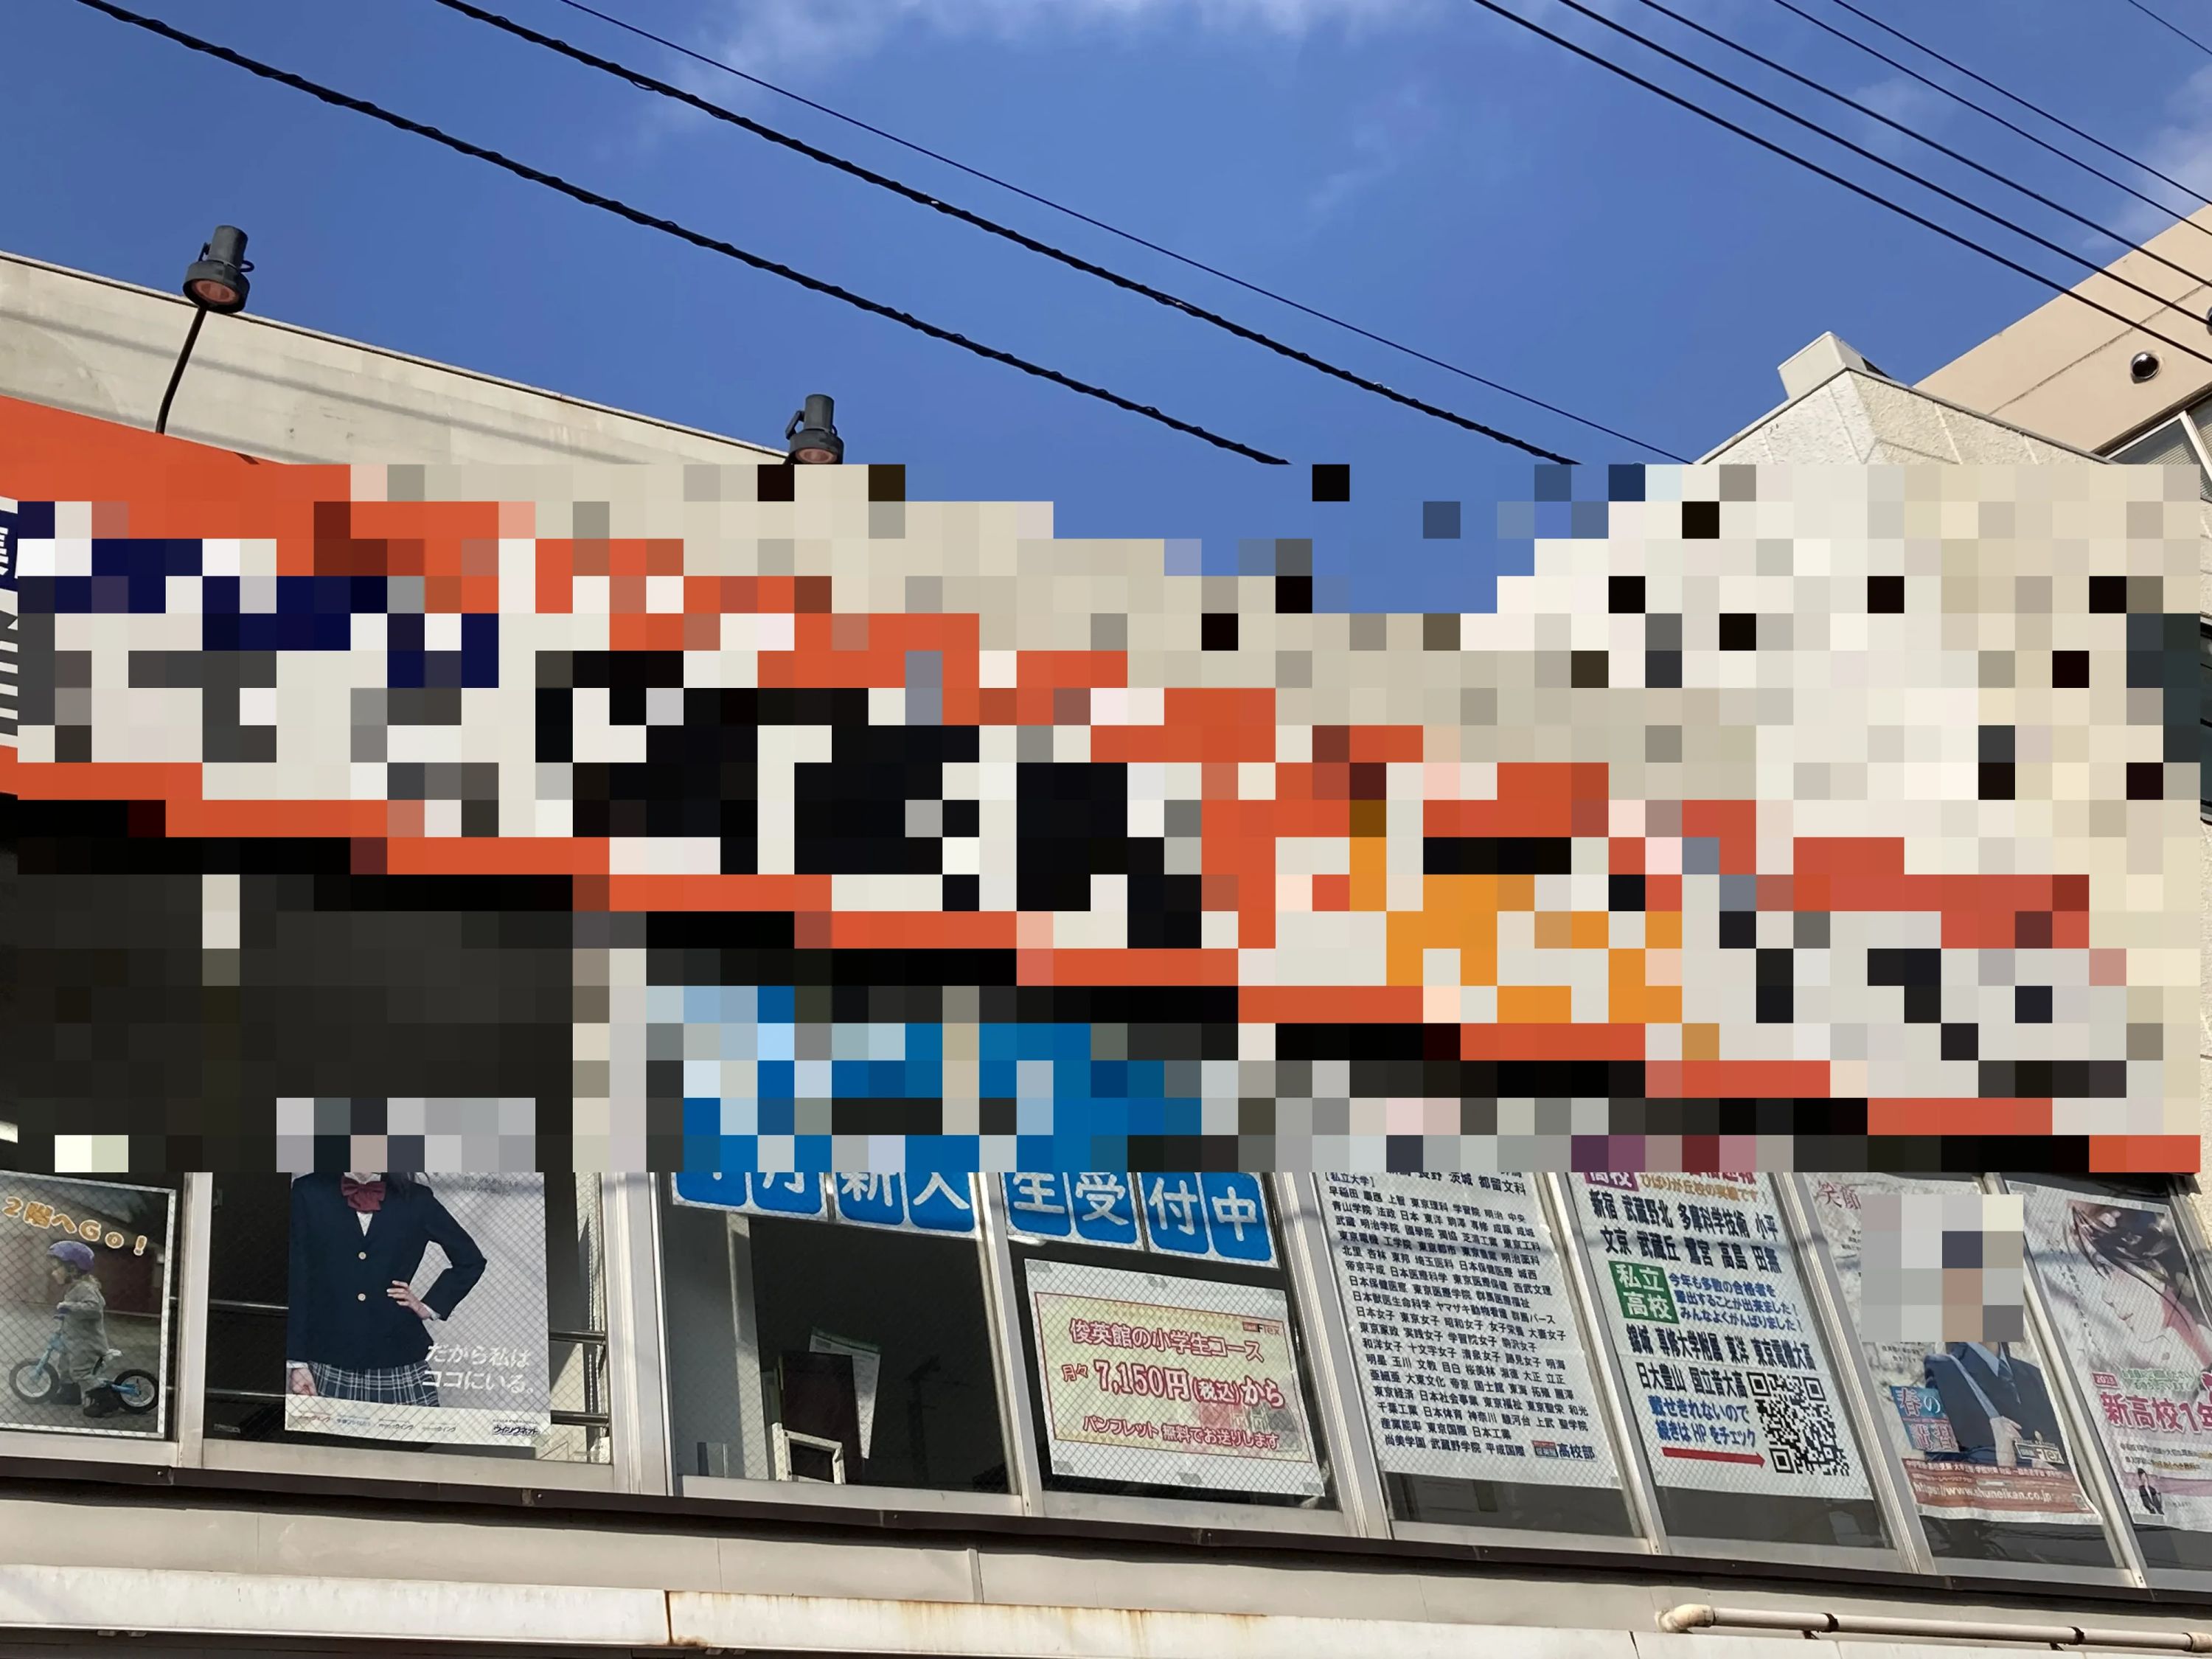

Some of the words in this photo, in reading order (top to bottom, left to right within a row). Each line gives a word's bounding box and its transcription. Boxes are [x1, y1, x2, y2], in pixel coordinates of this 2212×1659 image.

[1478, 1175, 1526, 1196] 都留文科
[1329, 1186, 1359, 1199] 早稲田
[1388, 1194, 1405, 1206] 上智
[1410, 1197, 1448, 1211] 東京理科
[1453, 1203, 1481, 1217] 学習院
[1484, 1209, 1503, 1220] 明治
[1507, 1213, 1526, 1223] 中央
[1332, 1200, 1372, 1215] 青山学院
[1376, 1206, 1396, 1219] 法政
[1400, 1210, 1419, 1222] 日本
[1423, 1213, 1443, 1225] 東洋
[1516, 1226, 1535, 1238] 成城
[1589, 1189, 1618, 1220] 新宿
[1621, 1194, 1673, 1228] 武蔵野北
[1677, 1202, 1750, 1239] 多摩科学技術
[1755, 1211, 1778, 1242] 小平
[1335, 1215, 1356, 1227] 武蔵
[1360, 1218, 1399, 1234] 明治学院
[1503, 1238, 1540, 1251] 東京工科
[1338, 1231, 1379, 1245] 東京電機
[1383, 1236, 1412, 1250] 工学院
[1417, 1241, 1456, 1255] 東京都市
[1501, 1252, 1540, 1266] 明治薬科
[1342, 1245, 1363, 1257] 北里
[1367, 1248, 1387, 1260] 杏林
[1391, 1252, 1411, 1264] 東邦
[1415, 1255, 1454, 1269] 埼玉医科
[1517, 1267, 1537, 1280] 城西
[1600, 1225, 1632, 1255] 文京
[1637, 1230, 1681, 1261] 武蔵丘
[1717, 1241, 1748, 1270] 高島
[1750, 1245, 1781, 1273] 田無
[1345, 1260, 1385, 1275] 帝京平成
[1390, 1267, 1448, 1283] 日本医療科学
[1453, 1273, 1509, 1291] 東京医療保健
[1512, 1282, 1552, 1295] 西武文理
[1615, 1264, 1664, 1292] 私立
[1669, 1273, 1776, 1298] 今年も多数の合格者を
[1353, 1291, 1431, 1310] 日本獣医生命科学
[1436, 1303, 1508, 1319] ヤマザキ動物看護
[1412, 1284, 1472, 1300] 東京医療学院
[1476, 1290, 1530, 1308] 群馬医療福祉
[1623, 1291, 1672, 1320] 高校
[1356, 1307, 1395, 1321] 日本女子
[1399, 1312, 1440, 1326] 東京女子
[1444, 1317, 1484, 1330] 昭和女子
[1489, 1321, 1525, 1337] 女子栄養
[1528, 1328, 1566, 1340] 大妻女子
[1359, 1321, 1399, 1337] 東京家政
[1403, 1327, 1443, 1342] 実践女子
[1448, 1332, 1498, 1347] 学習院女子
[1501, 1337, 1537, 1352] 駒沢女子
[425, 1343, 532, 1368] だから私は
[1070, 1318, 1265, 1363] 俊英館の小学生コース
[1363, 1338, 1403, 1352] 和洋女子
[1408, 1343, 1457, 1358] 十文字女子
[1461, 1349, 1500, 1362] 清泉女子
[1545, 1358, 1565, 1370] 明海
[1655, 1327, 1724, 1362] 専修大学附属
[1725, 1334, 1750, 1365] 東洋
[1750, 1337, 1817, 1371] 東京電機大高
[422, 1370, 534, 1394] ココにいる。
[1062, 1363, 1089, 1382] 月々
[1366, 1354, 1388, 1366] 明星
[1391, 1356, 1412, 1368] 玉川
[1416, 1359, 1438, 1371] 文教
[1441, 1362, 1461, 1374] 目白
[1465, 1365, 1495, 1377] 桜美林
[1523, 1371, 1542, 1382] 大正
[1545, 1374, 1565, 1385] 立正
[1369, 1369, 1401, 1382] 亜細亜
[1405, 1373, 1446, 1388] 大東文化
[1450, 1377, 1470, 1390] 帝京
[1508, 1383, 1528, 1396] 東海
[1531, 1385, 1551, 1398] 拓殖
[1635, 1362, 1687, 1392] 日大豊山
[1688, 1366, 1748, 1398] 国立音大高
[1373, 1385, 1414, 1399] 東京経済
[1419, 1390, 1479, 1406] 日本社会事業
[1483, 1397, 1523, 1411] 東京福祉
[1526, 1400, 1565, 1414] 東京聖栄
[1568, 1404, 1588, 1416] 和光
[1648, 1395, 1750, 1424] 載せきれないので
[1895, 1388, 1941, 1416] 春の
[1377, 1402, 1419, 1416] 千葉工業
[1423, 1406, 1462, 1420] 日本体育
[1467, 1410, 1498, 1423] 神奈川
[1501, 1413, 1531, 1427] 駿河台
[1537, 1417, 1555, 1428] 上武
[1558, 1418, 1589, 1431] 聖学院
[1426, 1422, 1468, 1436] 東京国際
[1472, 1426, 1512, 1440] 日本工業
[1083, 1415, 1159, 1437] パンフレット
[1161, 1424, 1280, 1450] 無料でお送りします
[1385, 1434, 1426, 1449] 尚美学園
[1430, 1439, 1481, 1453] 武蔵野学院
[1486, 1442, 1526, 1457] 平成国際
[1557, 1442, 1595, 1459] 高校部
